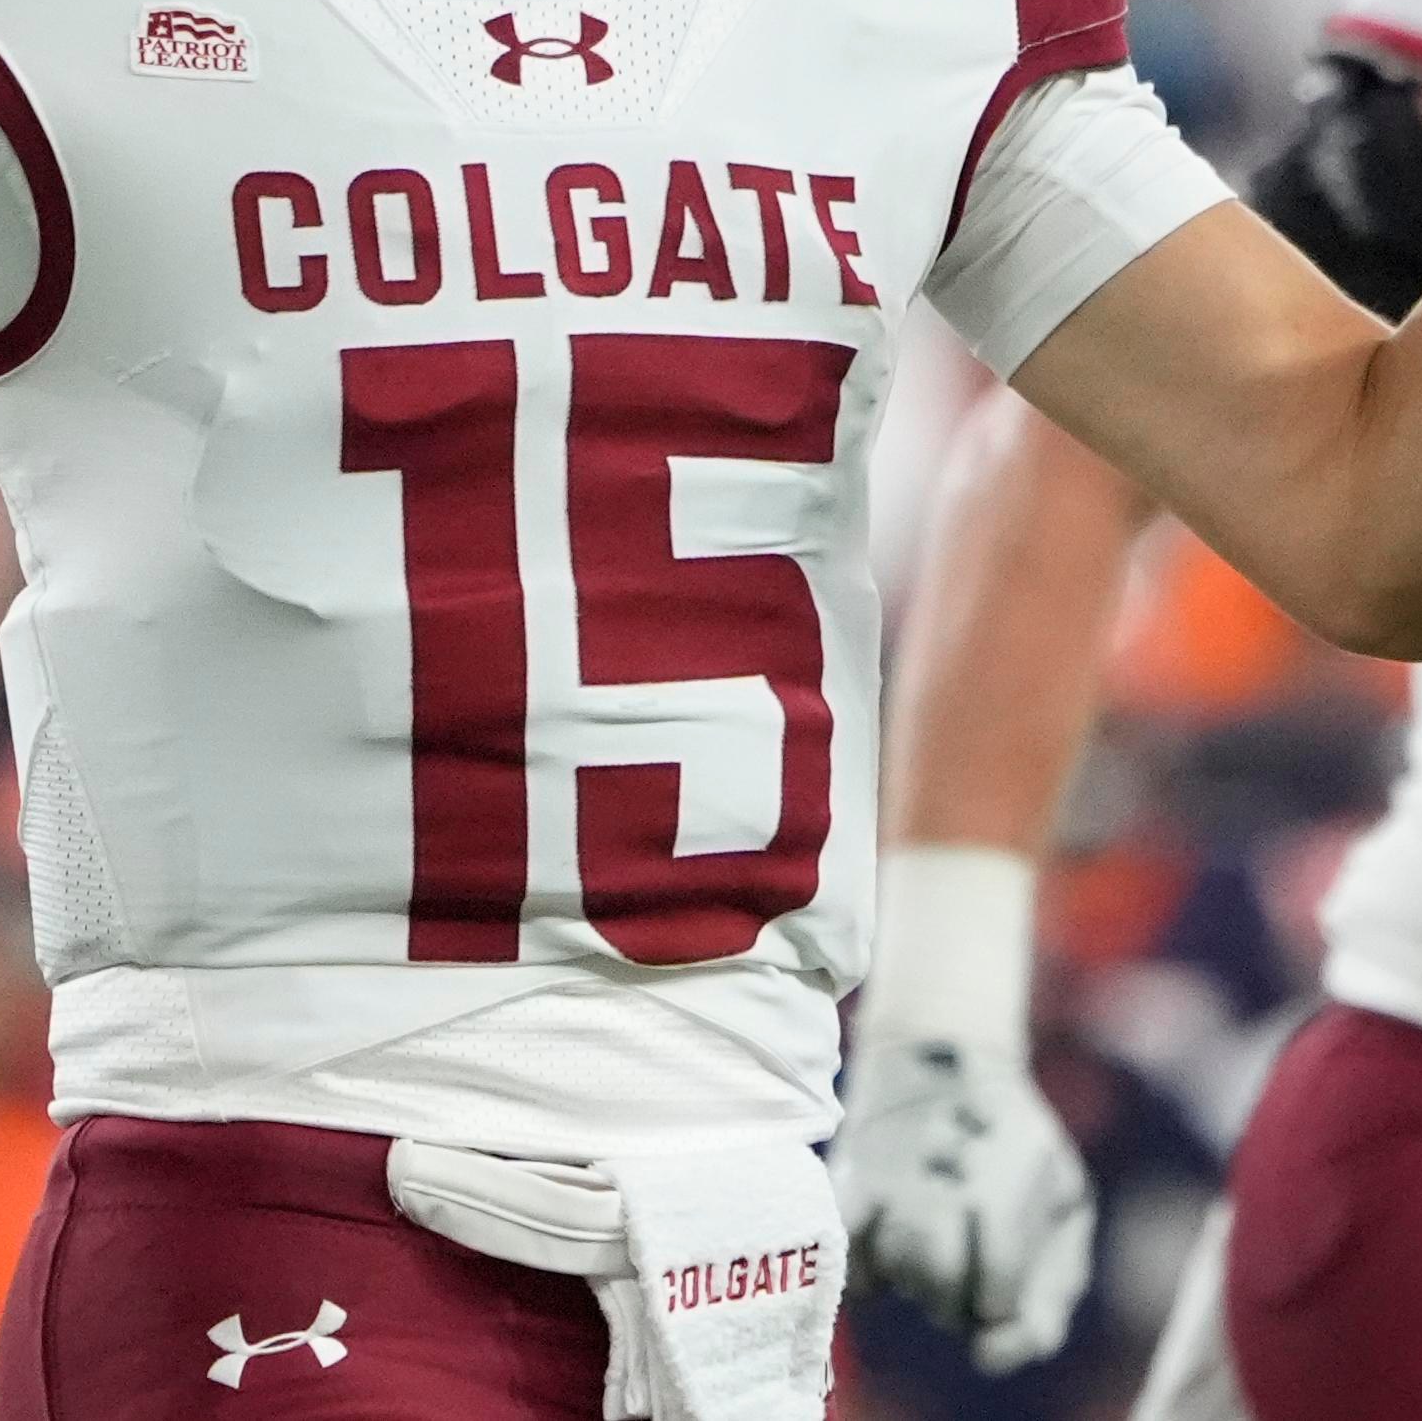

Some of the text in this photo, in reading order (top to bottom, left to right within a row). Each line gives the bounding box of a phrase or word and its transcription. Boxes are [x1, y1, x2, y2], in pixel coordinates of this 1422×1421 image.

[137, 36, 247, 58] PATRIOT
[138, 50, 248, 72] LEAGUE
[231, 159, 881, 312] COLGATE
[340, 333, 858, 966] 15
